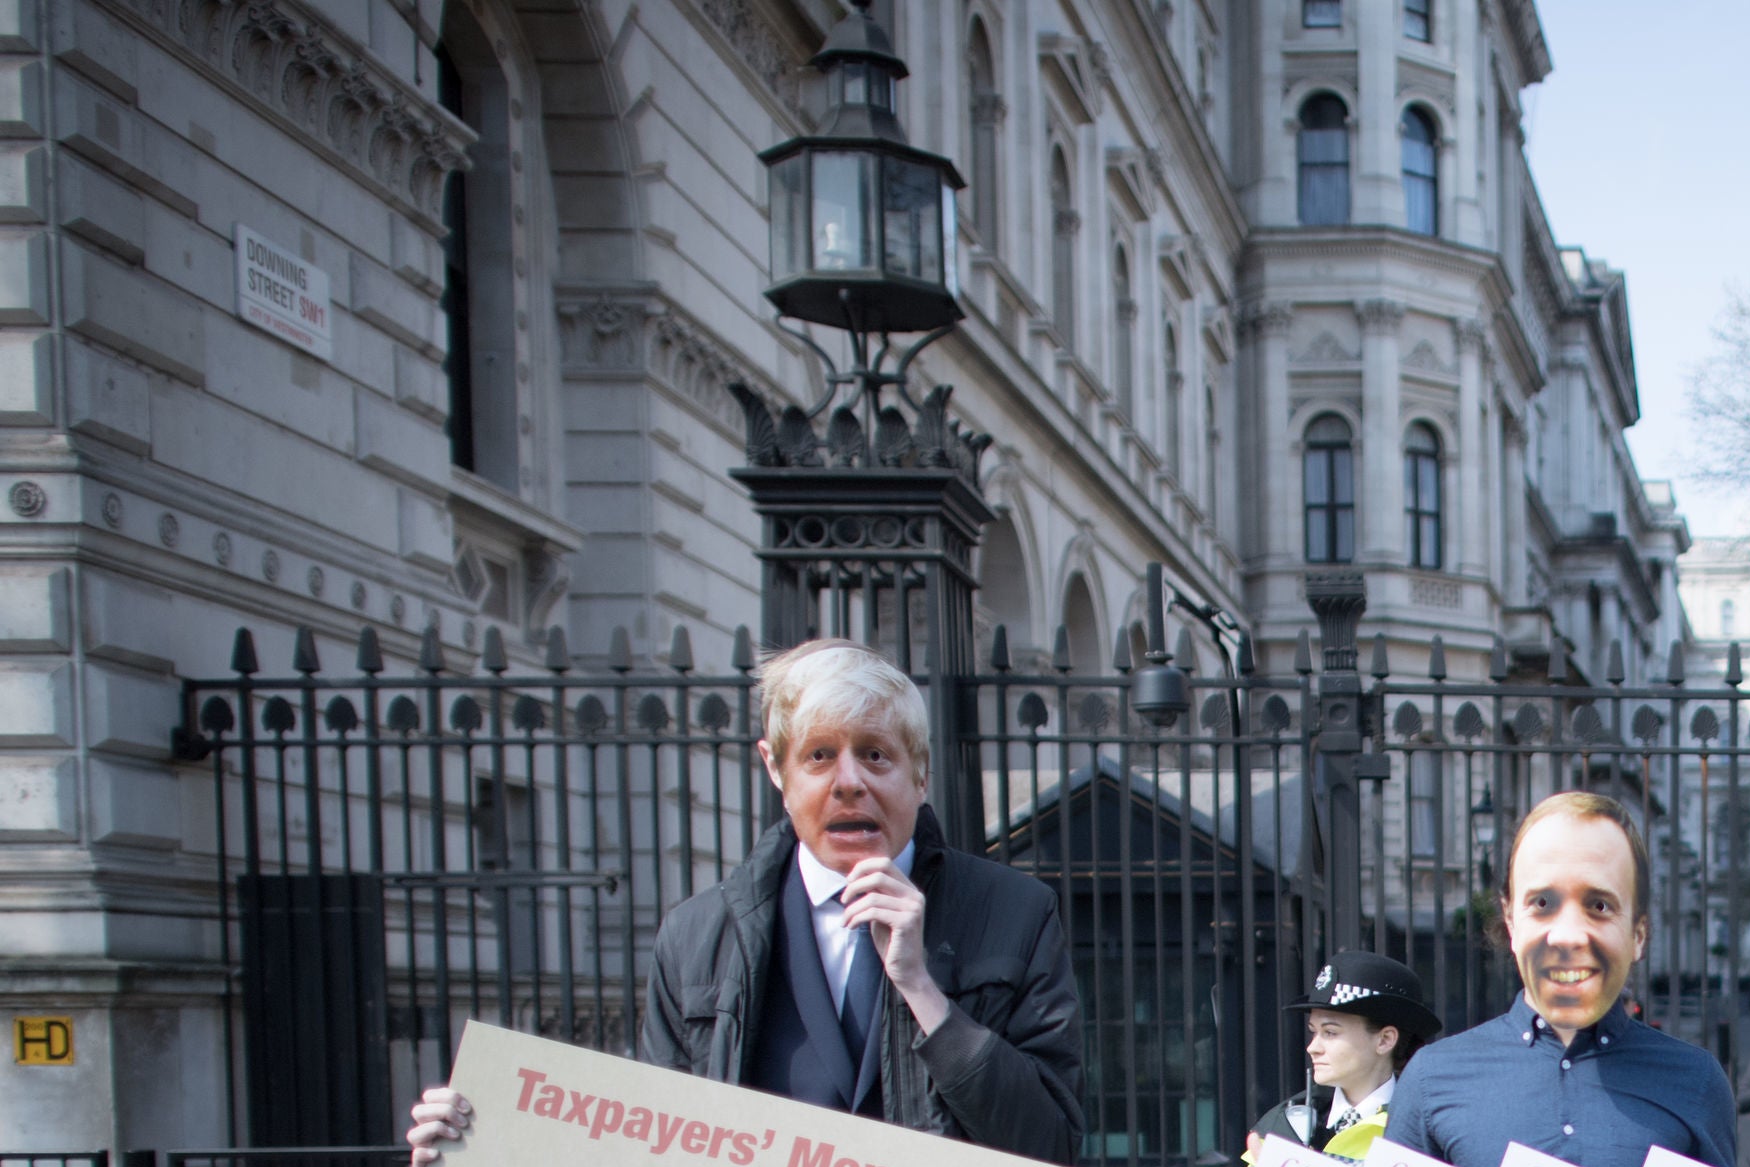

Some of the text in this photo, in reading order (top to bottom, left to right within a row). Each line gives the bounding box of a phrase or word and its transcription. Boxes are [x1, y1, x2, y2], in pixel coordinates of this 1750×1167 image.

[247, 238, 307, 291] DOWNING
[248, 268, 325, 328] STREET SW1
[19, 1021, 69, 1060] HD
[516, 1068, 775, 1166] Taxpayers’
